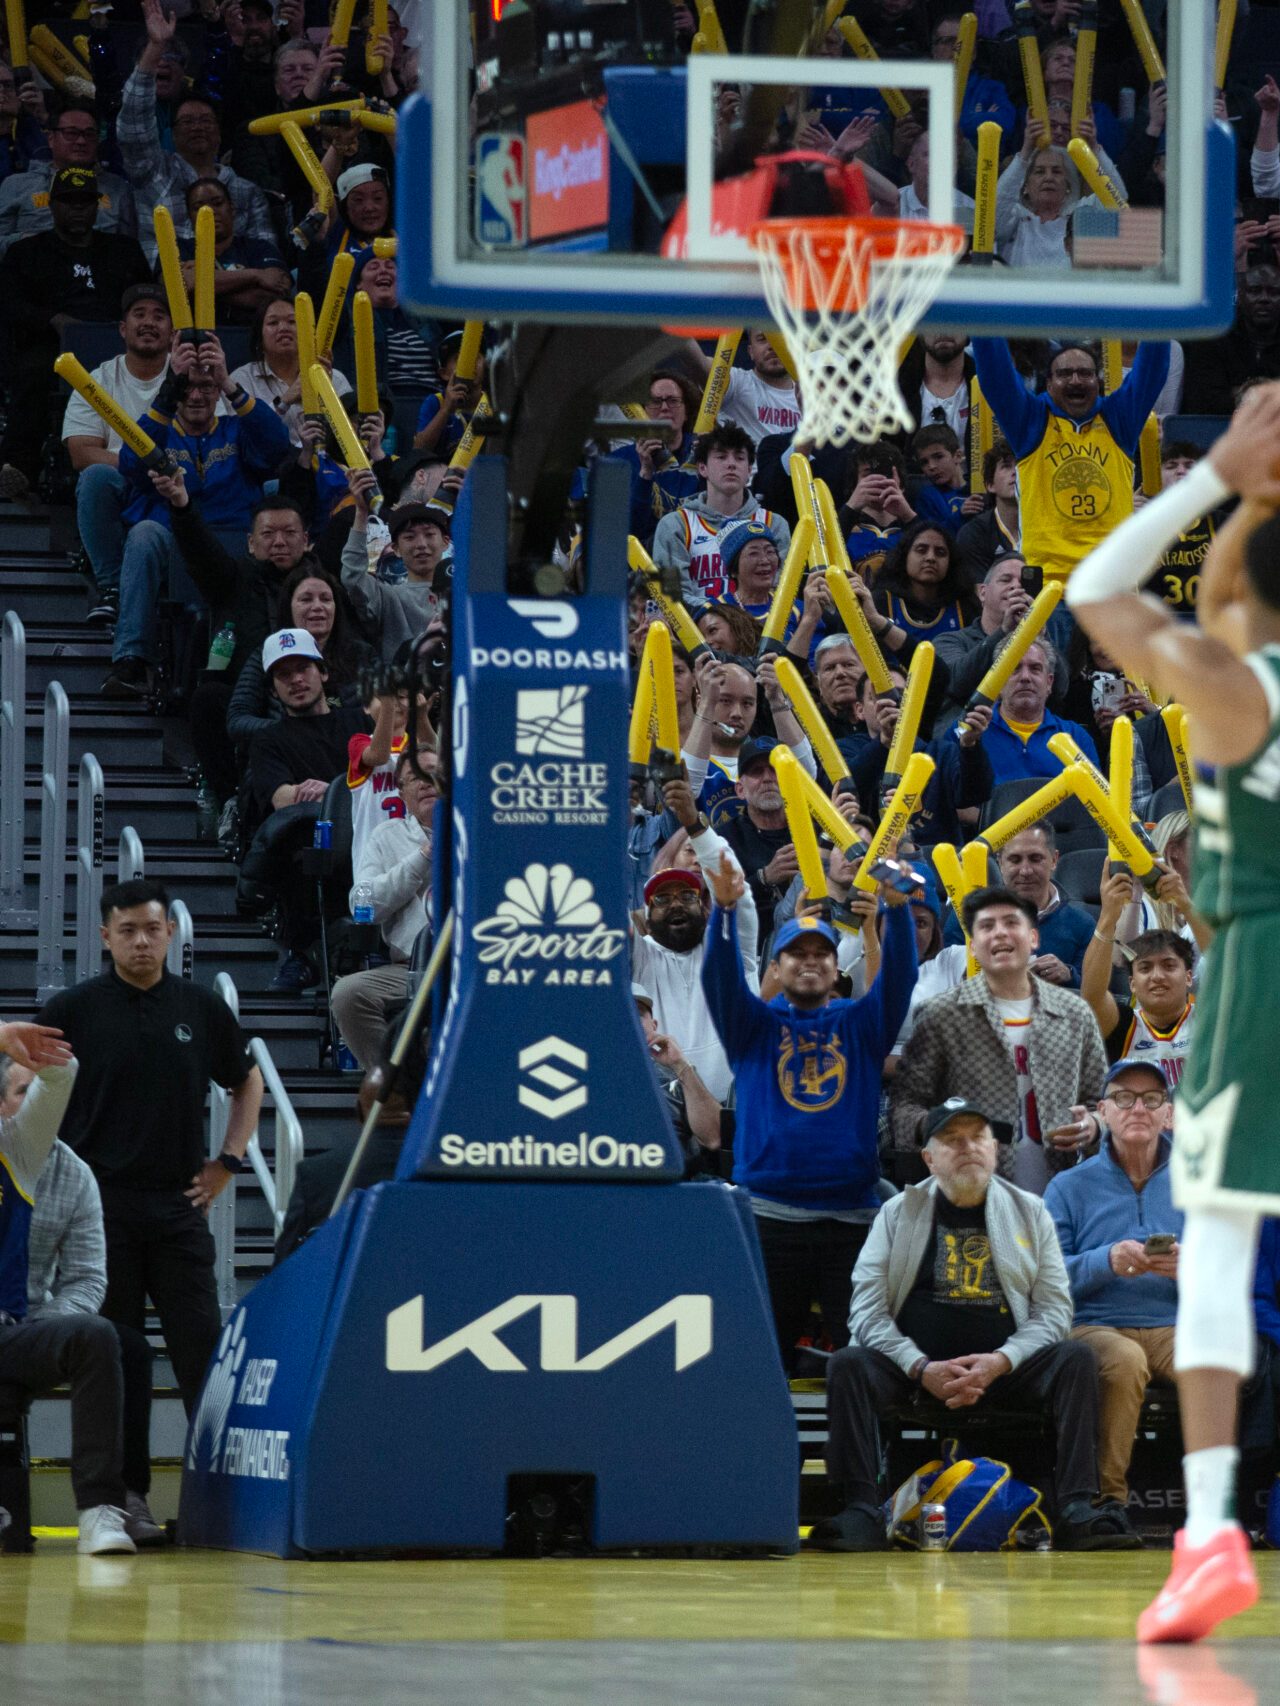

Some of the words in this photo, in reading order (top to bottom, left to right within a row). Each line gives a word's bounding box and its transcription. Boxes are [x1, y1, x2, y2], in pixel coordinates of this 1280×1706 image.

[979, 173, 989, 197] KAISER
[975, 199, 988, 247] PERMANENTE
[702, 364, 723, 415] WARRIORS
[1045, 442, 1109, 468] TOWN
[1071, 495, 1096, 516] 23
[471, 648, 626, 671] DOORDASH
[490, 762, 608, 786] CACHE
[490, 786, 608, 810] CREEK
[493, 812, 548, 824] CASINO
[555, 812, 608, 824] RESORT
[471, 914, 626, 970] Sports
[486, 969, 535, 985] BAY
[544, 969, 612, 986] AREA
[440, 1132, 664, 1168] SentinelOne
[238, 1359, 278, 1406] KAISER
[225, 1427, 290, 1480] PERMANENTE
[1125, 1490, 1186, 1509] ASE
